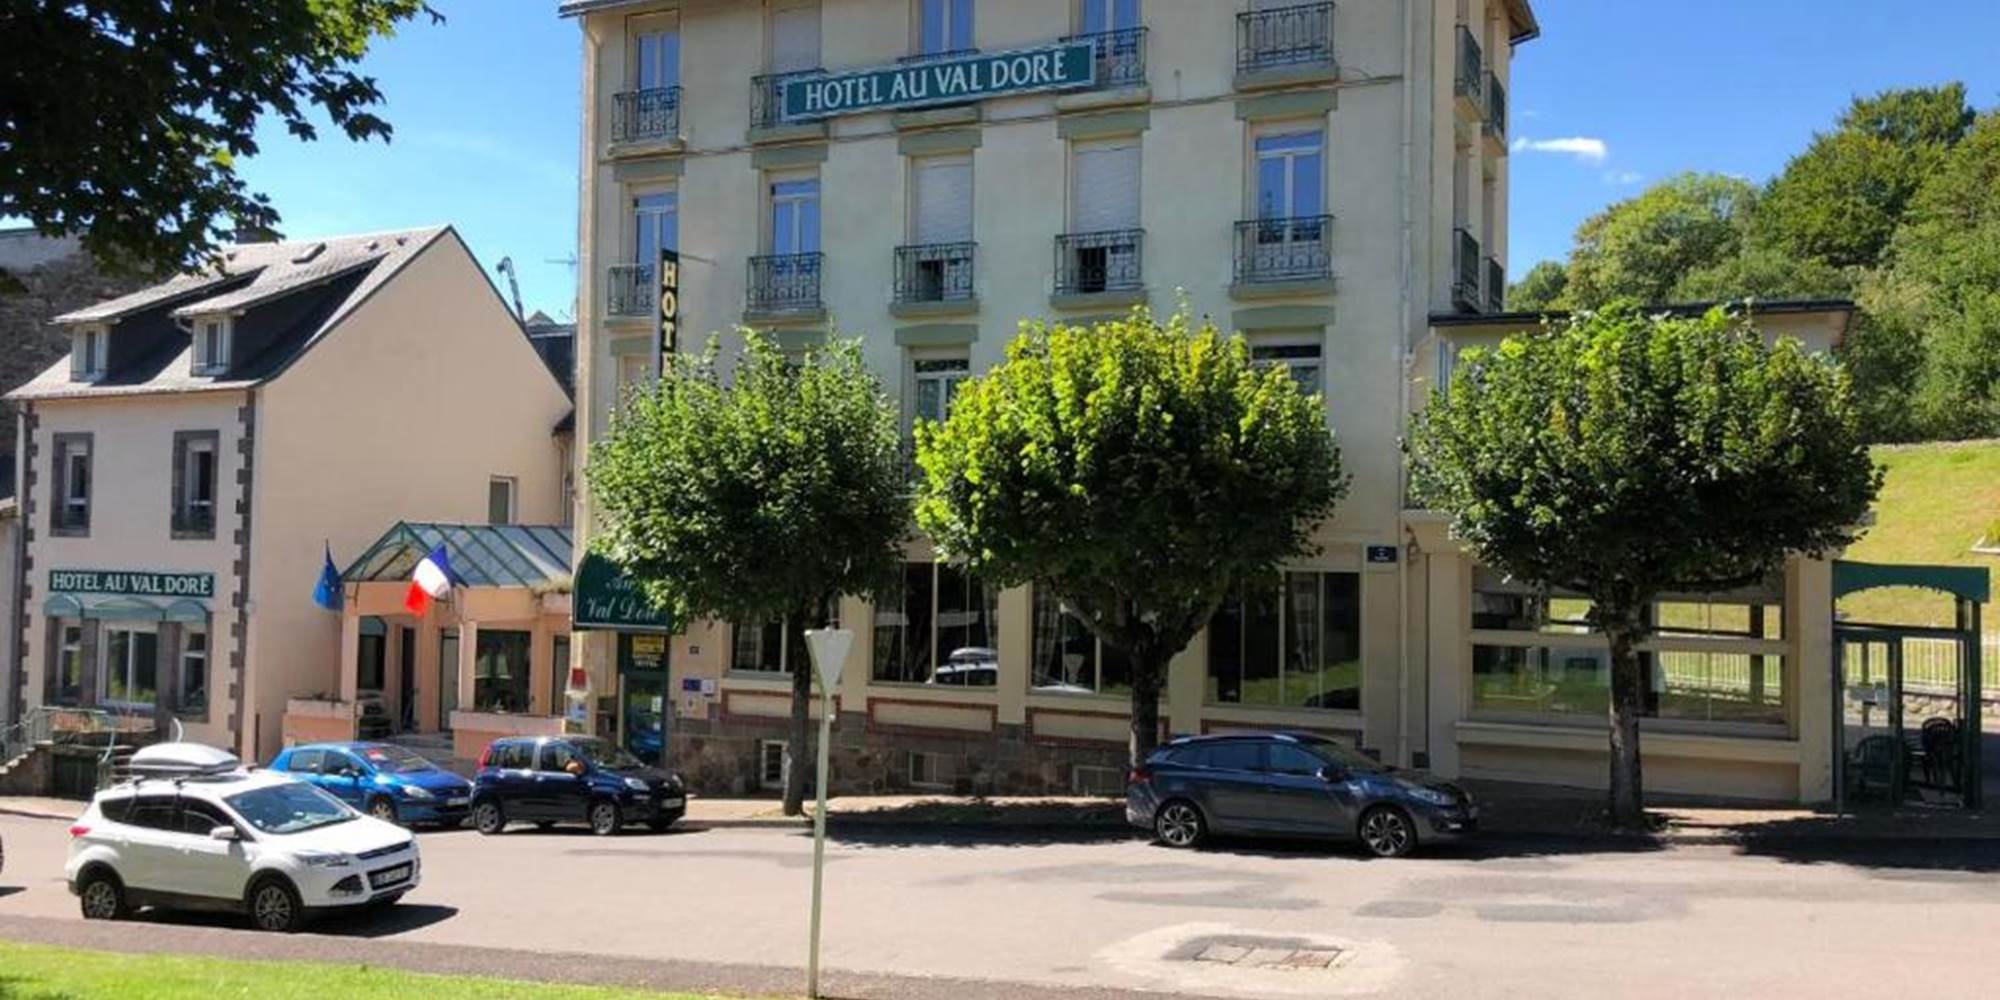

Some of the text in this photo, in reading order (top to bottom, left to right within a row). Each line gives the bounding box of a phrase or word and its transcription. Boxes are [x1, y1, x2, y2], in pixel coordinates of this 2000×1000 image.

[805, 74, 883, 110] HOTEL
[890, 70, 927, 101] AU
[934, 64, 983, 94] VAL
[662, 260, 677, 378] HOTE
[52, 572, 101, 590] HOTEL
[104, 574, 127, 591] AU
[131, 575, 161, 592] VAL
[587, 597, 616, 619] Val
